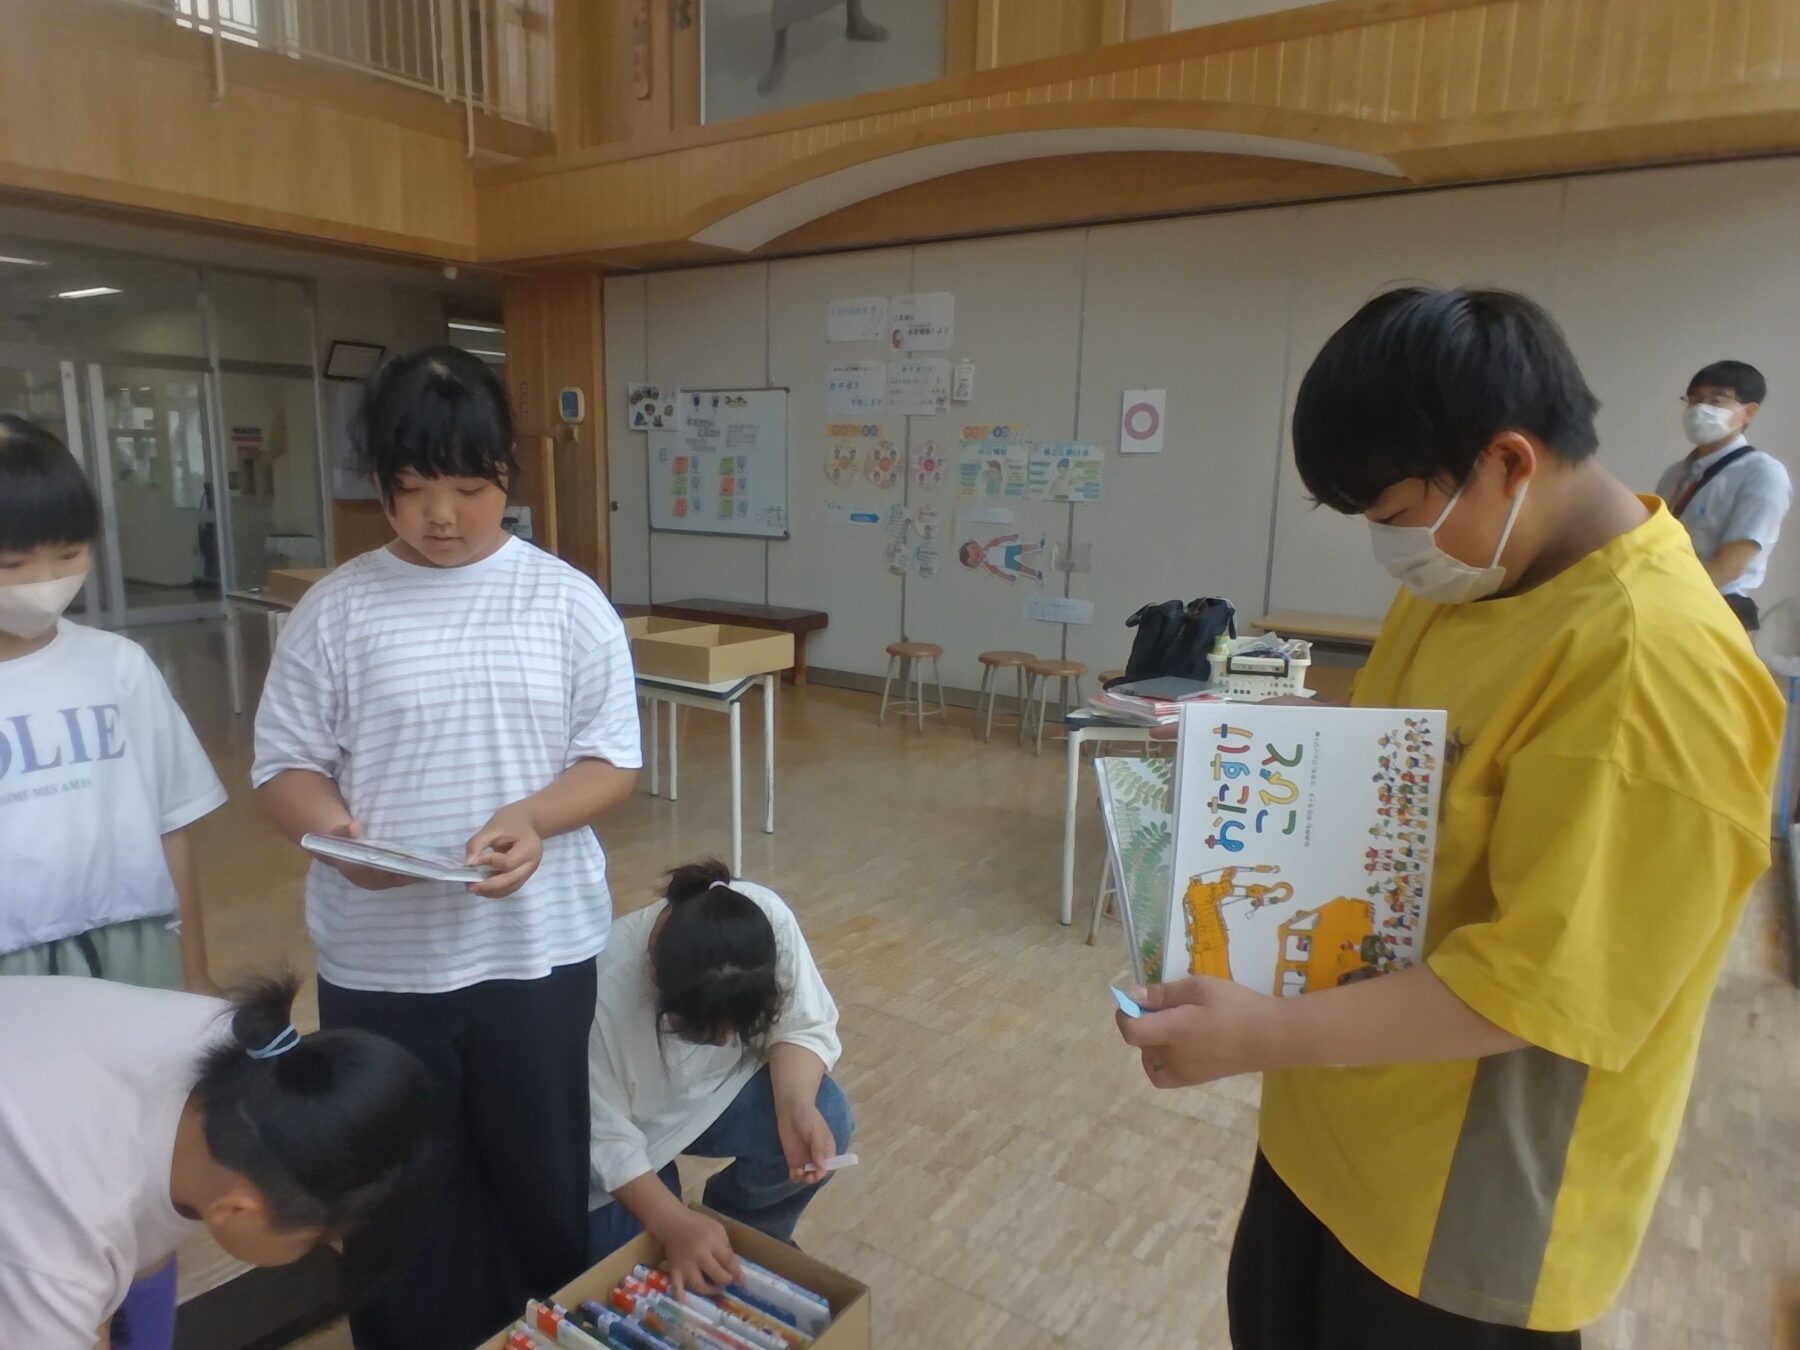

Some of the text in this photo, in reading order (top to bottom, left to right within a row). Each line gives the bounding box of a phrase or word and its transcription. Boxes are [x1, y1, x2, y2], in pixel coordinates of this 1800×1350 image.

[0, 704, 126, 780] LIE
[1204, 723, 1254, 852] おたすけ
[1255, 743, 1304, 835] こびと
